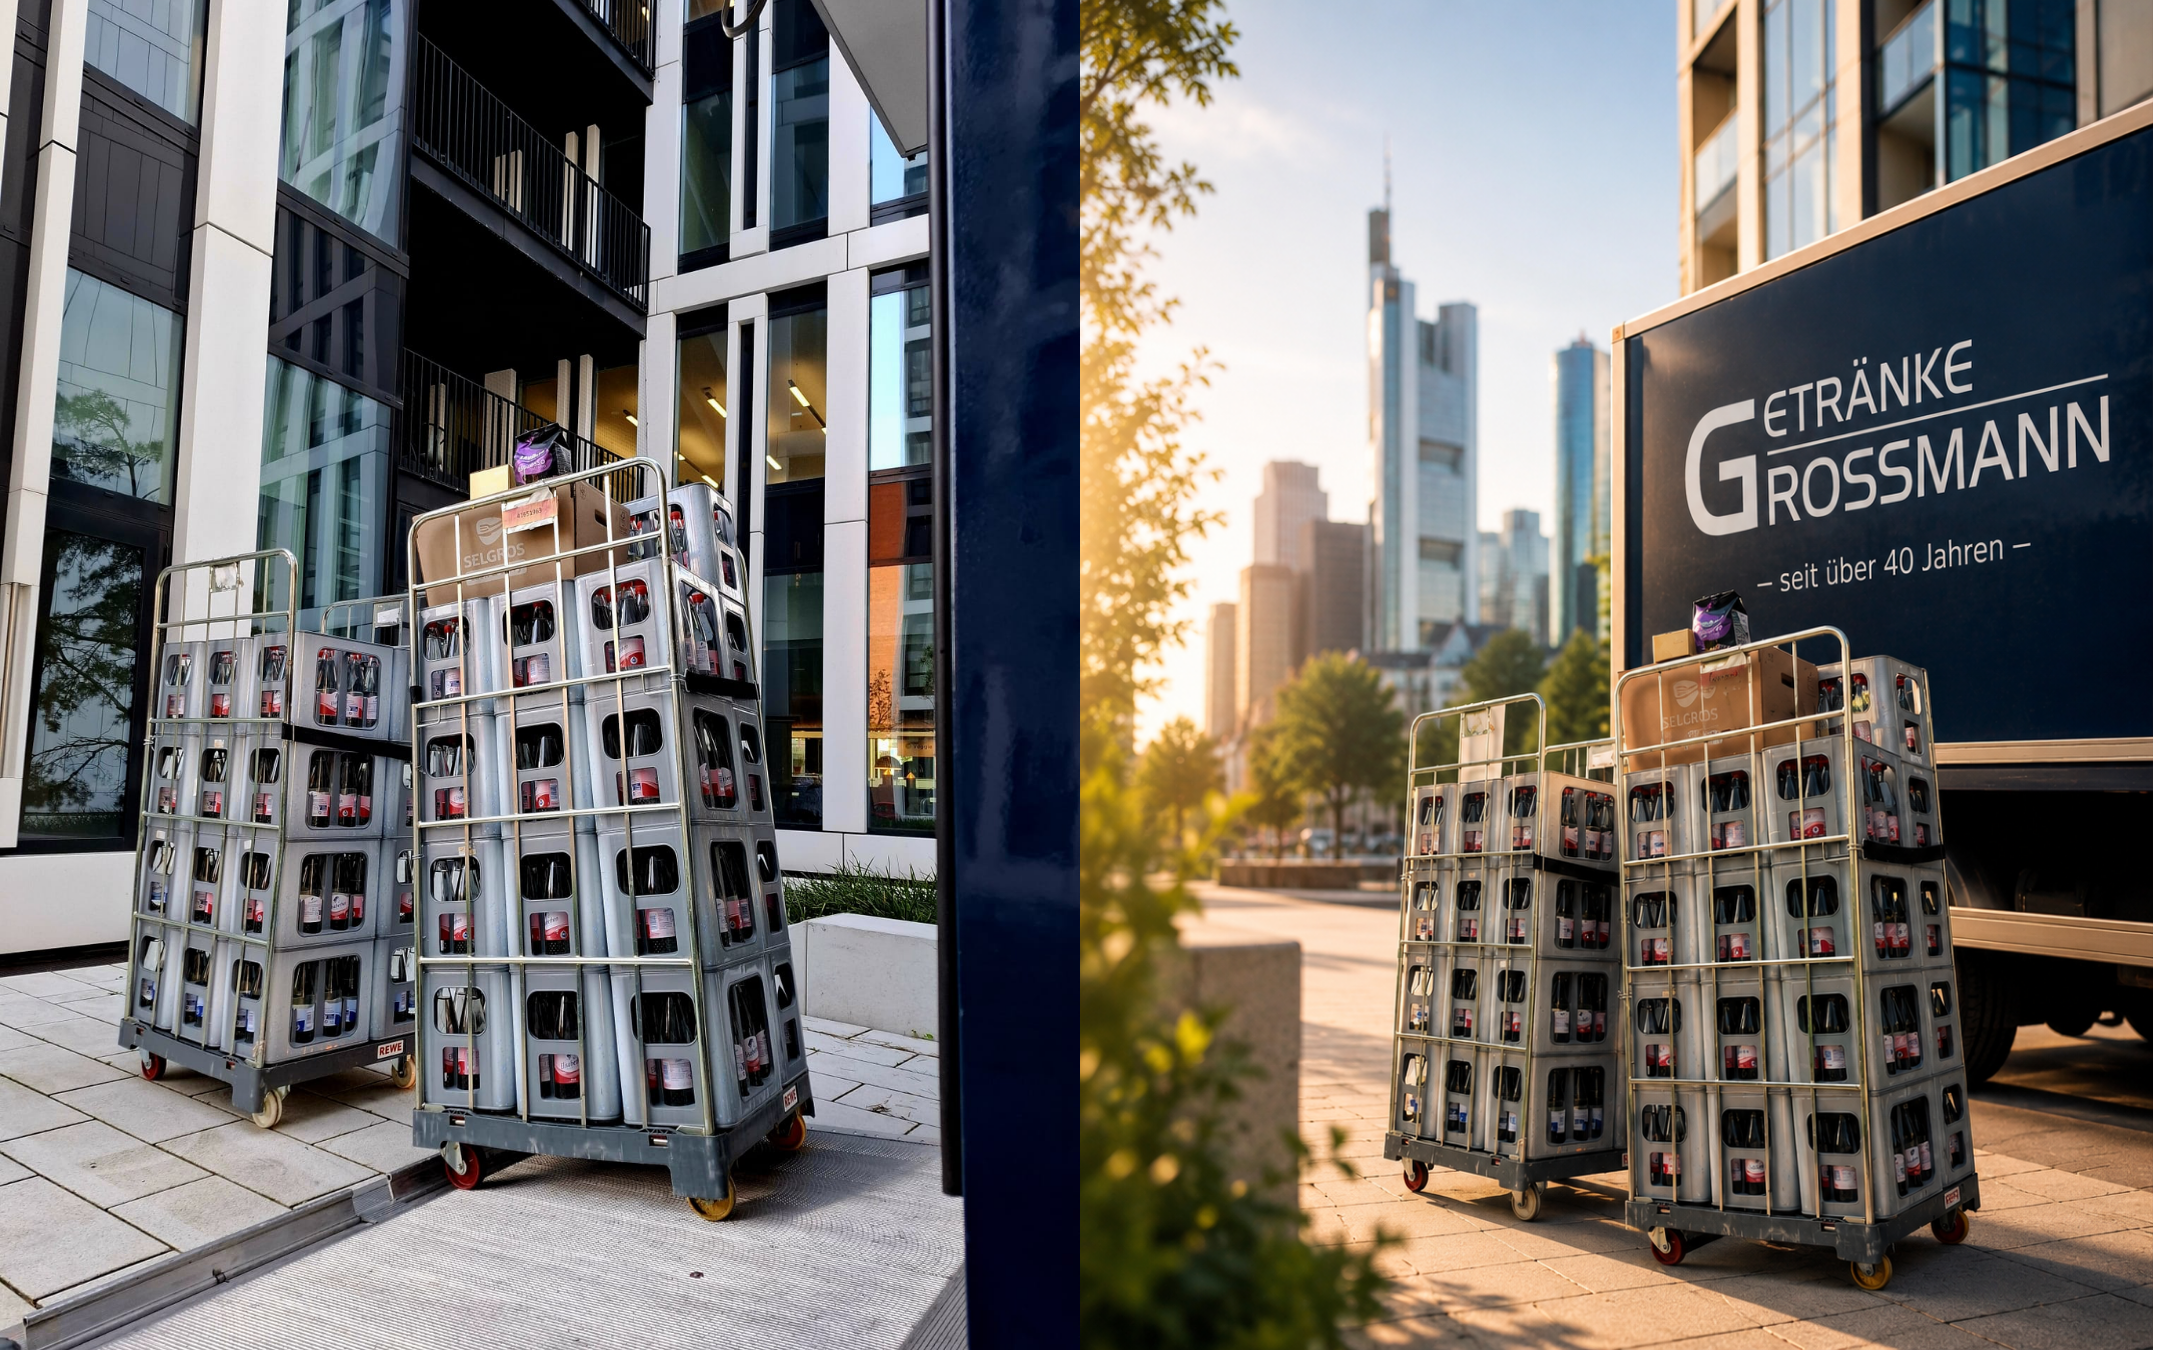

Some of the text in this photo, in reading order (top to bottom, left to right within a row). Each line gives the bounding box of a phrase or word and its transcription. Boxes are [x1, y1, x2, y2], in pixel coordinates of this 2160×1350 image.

[1685, 395, 2110, 536] GROSSMANN
[463, 542, 525, 568] SELGROS
[1780, 563, 1818, 592] seit
[1826, 557, 1876, 585] über
[1884, 546, 1914, 576] 40
[1922, 538, 2003, 572] Jahren
[1662, 707, 1718, 730] SELGROS
[379, 1042, 402, 1056] REWE
